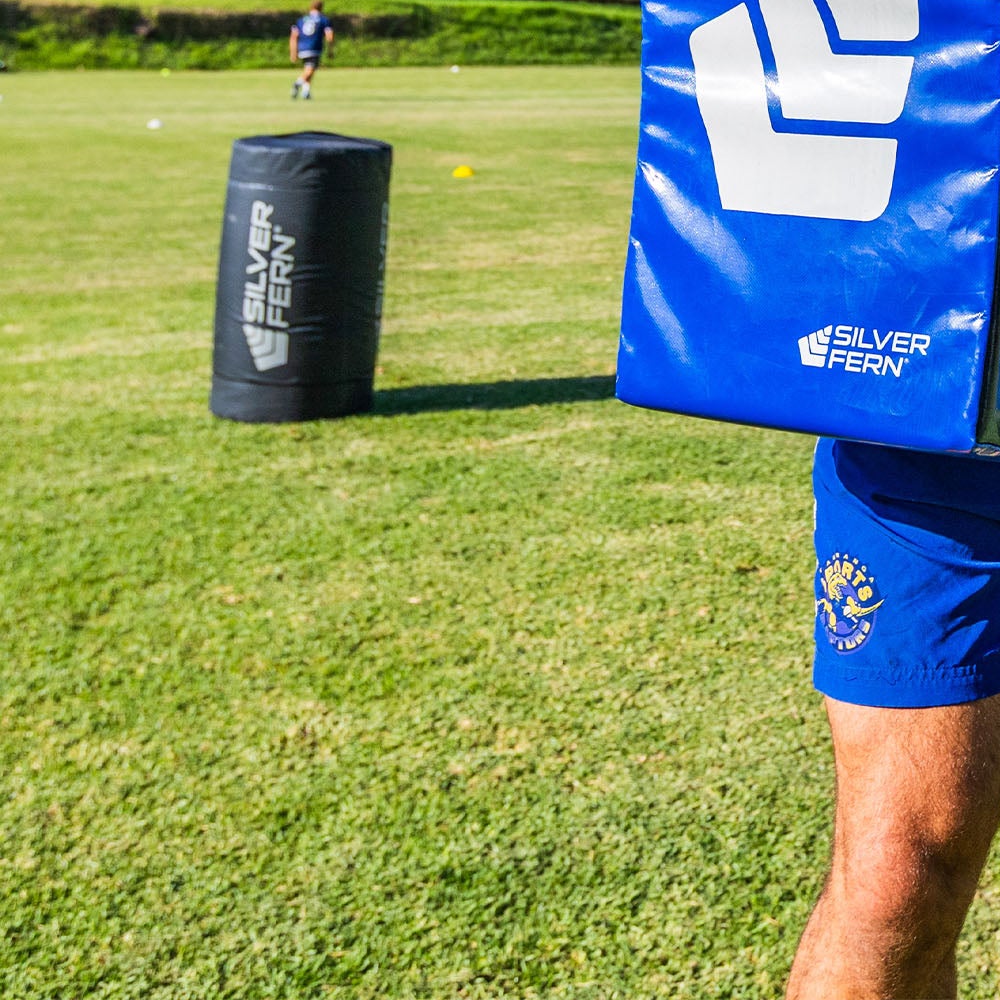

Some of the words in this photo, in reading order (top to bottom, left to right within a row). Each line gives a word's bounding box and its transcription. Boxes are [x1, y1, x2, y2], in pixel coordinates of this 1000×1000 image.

[242, 200, 274, 325] SILVER
[267, 235, 296, 329] FERN
[828, 349, 903, 378] FERN
[833, 325, 931, 356] SILVER
